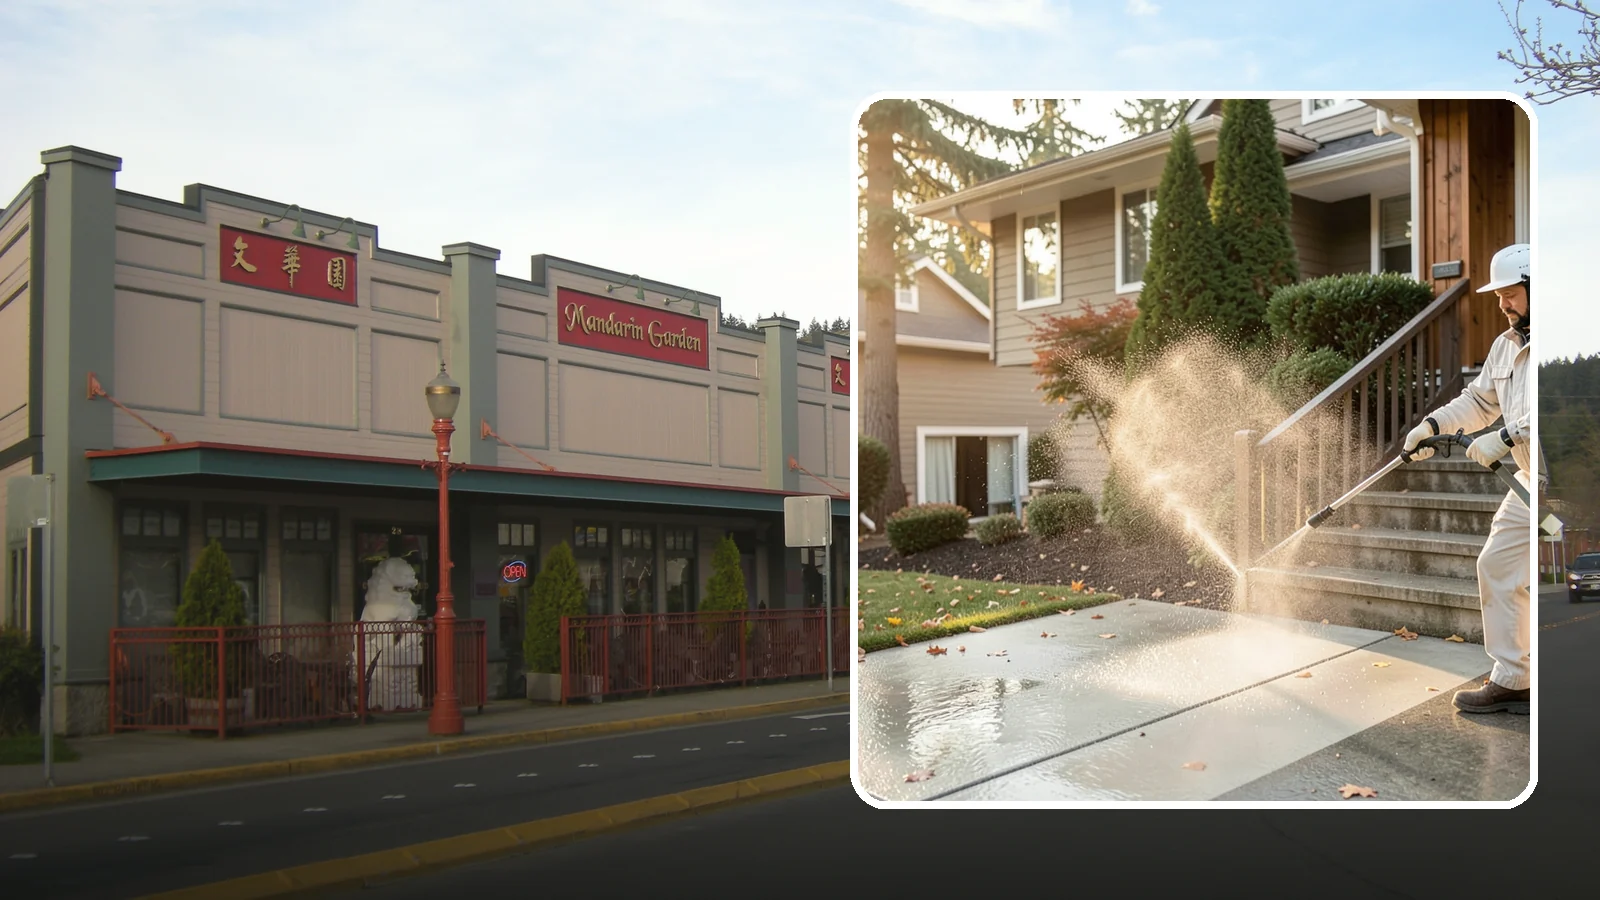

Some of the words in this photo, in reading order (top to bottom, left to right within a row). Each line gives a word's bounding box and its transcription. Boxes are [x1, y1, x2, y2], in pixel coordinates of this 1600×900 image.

[564, 302, 644, 341] Mandarin
[648, 320, 701, 352] Garden
[503, 565, 527, 578] OPEN
